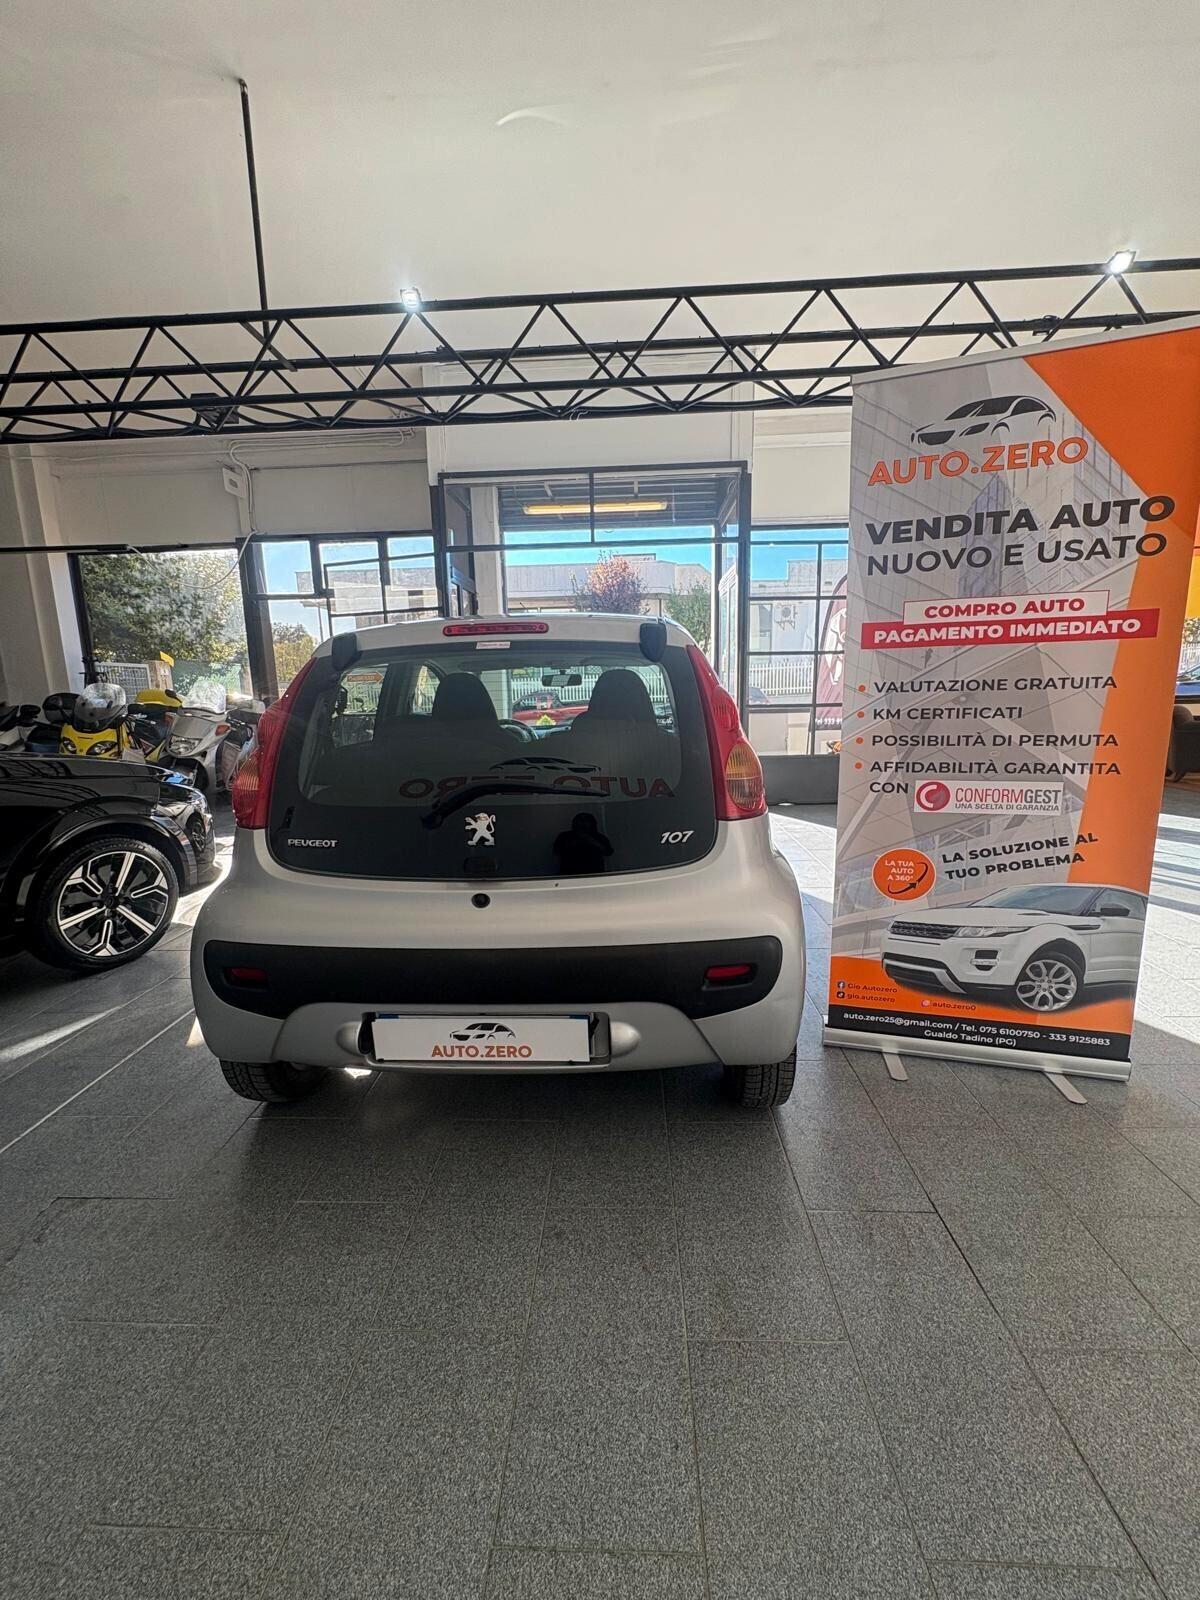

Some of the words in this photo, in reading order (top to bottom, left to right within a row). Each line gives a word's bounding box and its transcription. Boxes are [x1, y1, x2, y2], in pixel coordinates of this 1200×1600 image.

[868, 437, 1089, 486] AUTO.ZERO
[865, 508, 1038, 545] VENDITA
[1049, 495, 1175, 530] AUTO
[867, 546, 992, 577] NUOVO
[1004, 544, 1024, 566] E
[1037, 533, 1167, 563] USATO
[924, 602, 1017, 619] COMPRO
[1022, 598, 1085, 614] AUTO
[873, 624, 1004, 644] PAGAMENTO
[1009, 618, 1141, 638] IMMEDIATO
[874, 678, 1008, 693] VALUTAZIONE
[1014, 676, 1118, 690] GRATUITA
[873, 708, 901, 720] KM
[907, 706, 1023, 720] CERTIFICATI
[872, 732, 986, 747] POSSIBILITÀ
[992, 735, 1012, 747] DI
[1018, 734, 1119, 747] PERMUTA
[870, 759, 998, 774] AFFIDABILITÀ
[1004, 762, 1121, 775] GARANTITA
[869, 781, 909, 794] CON
[955, 788, 1061, 804] CONFORMGEST
[287, 839, 338, 848] PEUGEOT
[660, 830, 694, 844] 107
[942, 853, 964, 864] LA
[969, 836, 1069, 860] SOLUZIONE
[1075, 832, 1098, 844] AL
[945, 867, 980, 880] TUO
[985, 852, 1085, 874] PROBLEMA
[862, 984, 898, 993] Autozero
[843, 1012, 953, 1030] auto.zero25@gmail.com
[961, 1024, 977, 1032] Tel.
[979, 1025, 997, 1034] 075
[1000, 1028, 1040, 1039] 6100750
[1049, 1033, 1067, 1041] 333
[1069, 1035, 1111, 1046] 9125883
[924, 1030, 958, 1040] Gualdo
[960, 1033, 993, 1043] Tadino
[995, 1038, 1017, 1047] (PG)
[431, 1045, 532, 1058] AUTO.ZERO
